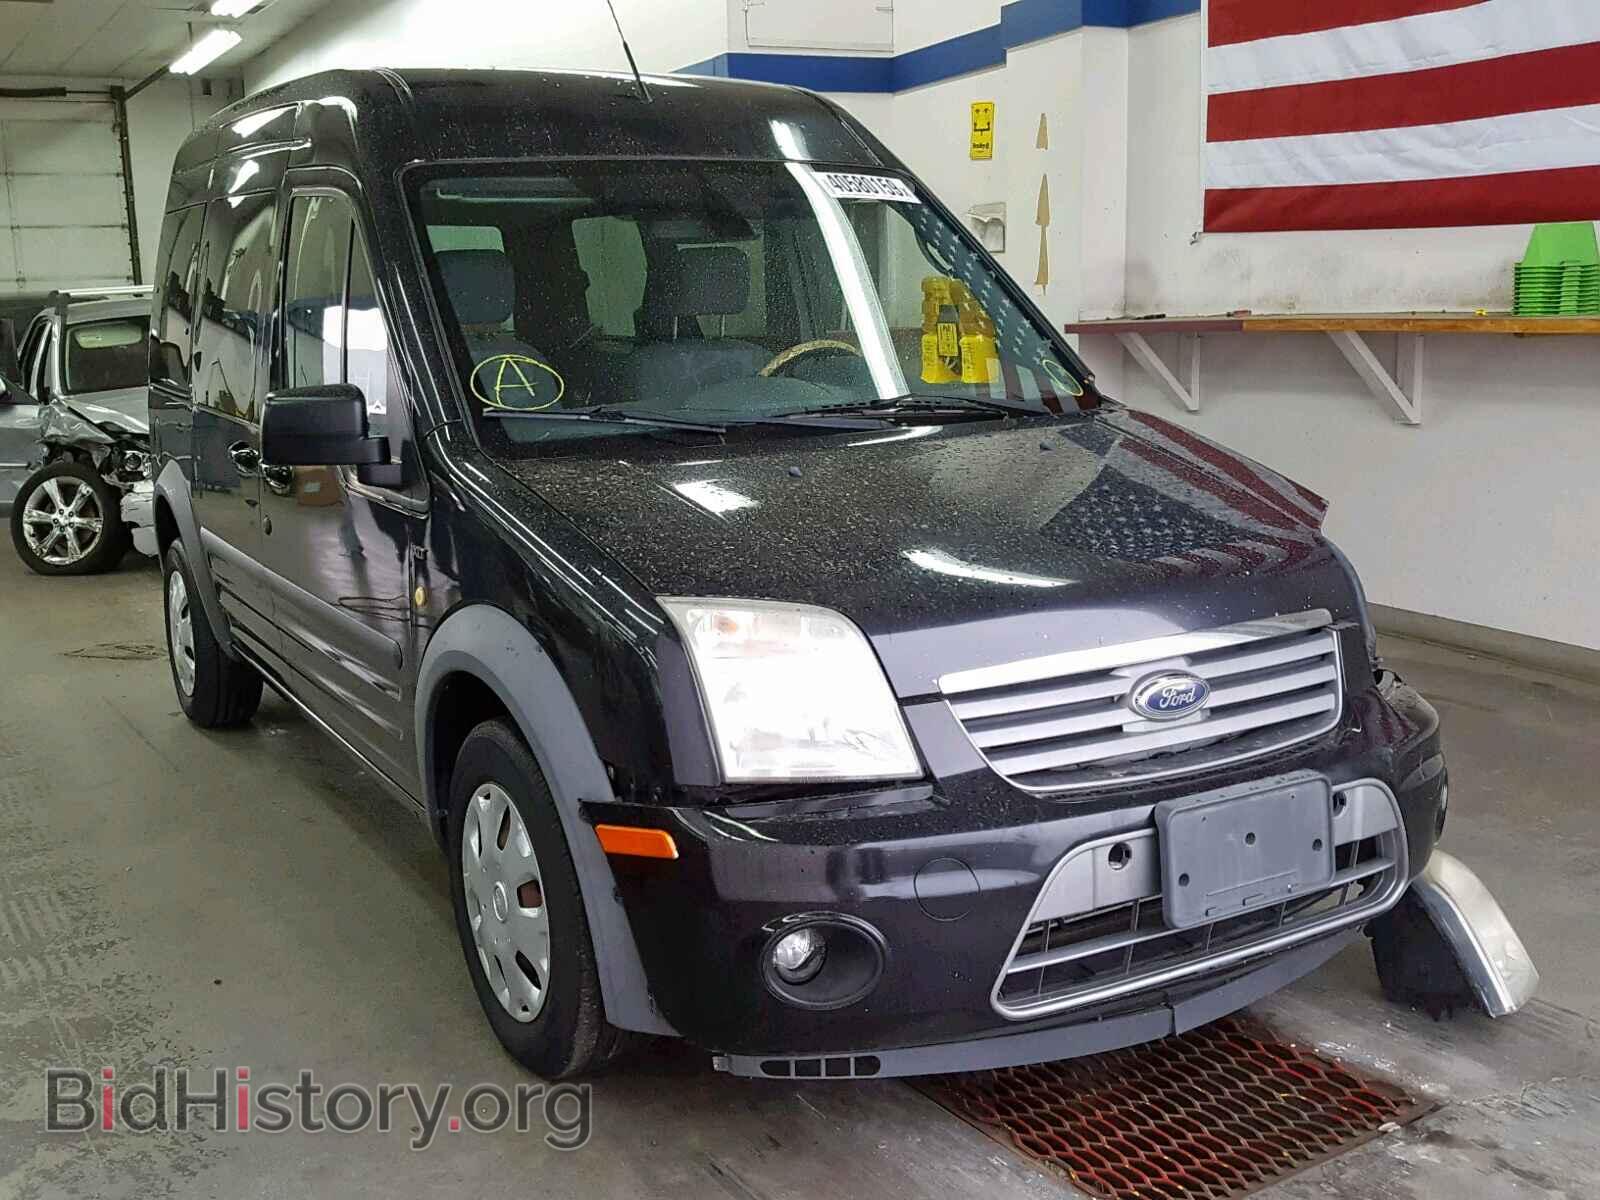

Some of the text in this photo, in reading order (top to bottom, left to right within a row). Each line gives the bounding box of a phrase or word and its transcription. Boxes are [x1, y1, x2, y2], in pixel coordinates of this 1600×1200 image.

[826, 174, 904, 197] 40580159
[494, 358, 537, 406] A
[1159, 686, 1196, 709] Ford
